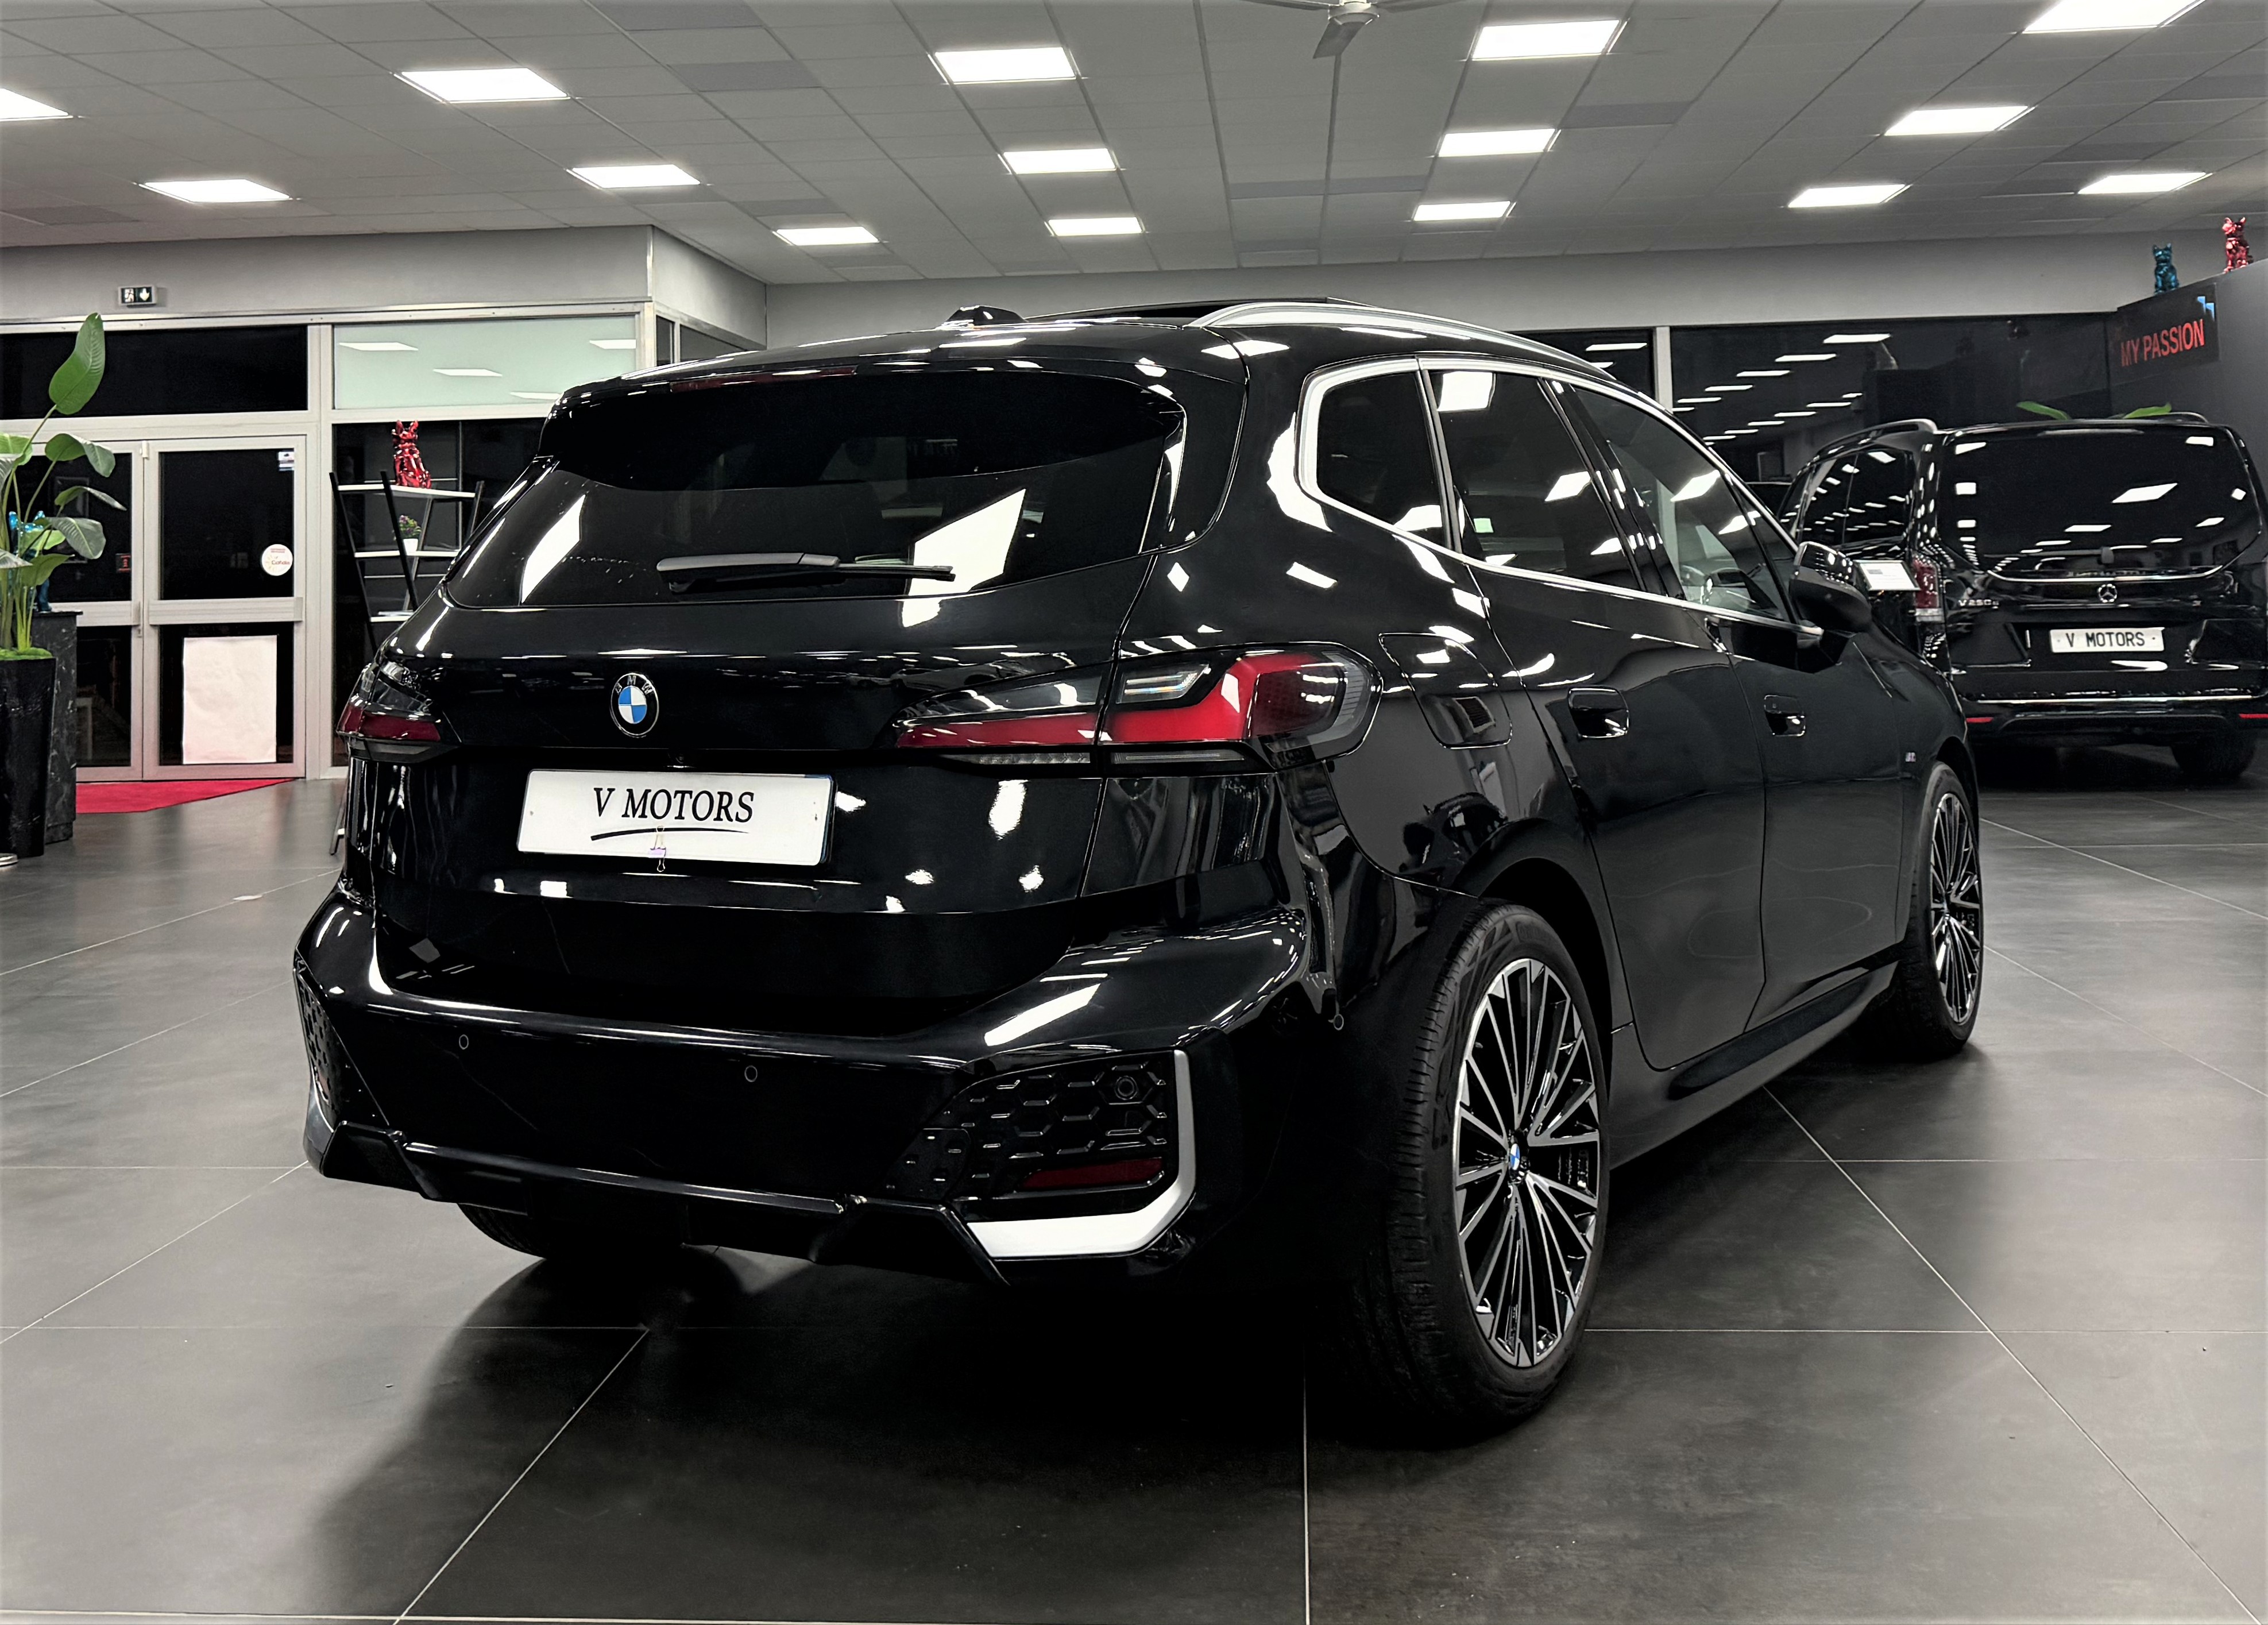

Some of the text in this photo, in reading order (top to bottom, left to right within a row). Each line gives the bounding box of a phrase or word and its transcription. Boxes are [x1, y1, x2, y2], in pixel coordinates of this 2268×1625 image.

[2121, 318, 2204, 367] MY PASSION
[2066, 631, 2146, 647] V MOTORS
[615, 674, 654, 696] BMW
[593, 787, 755, 823] V MOTORS
